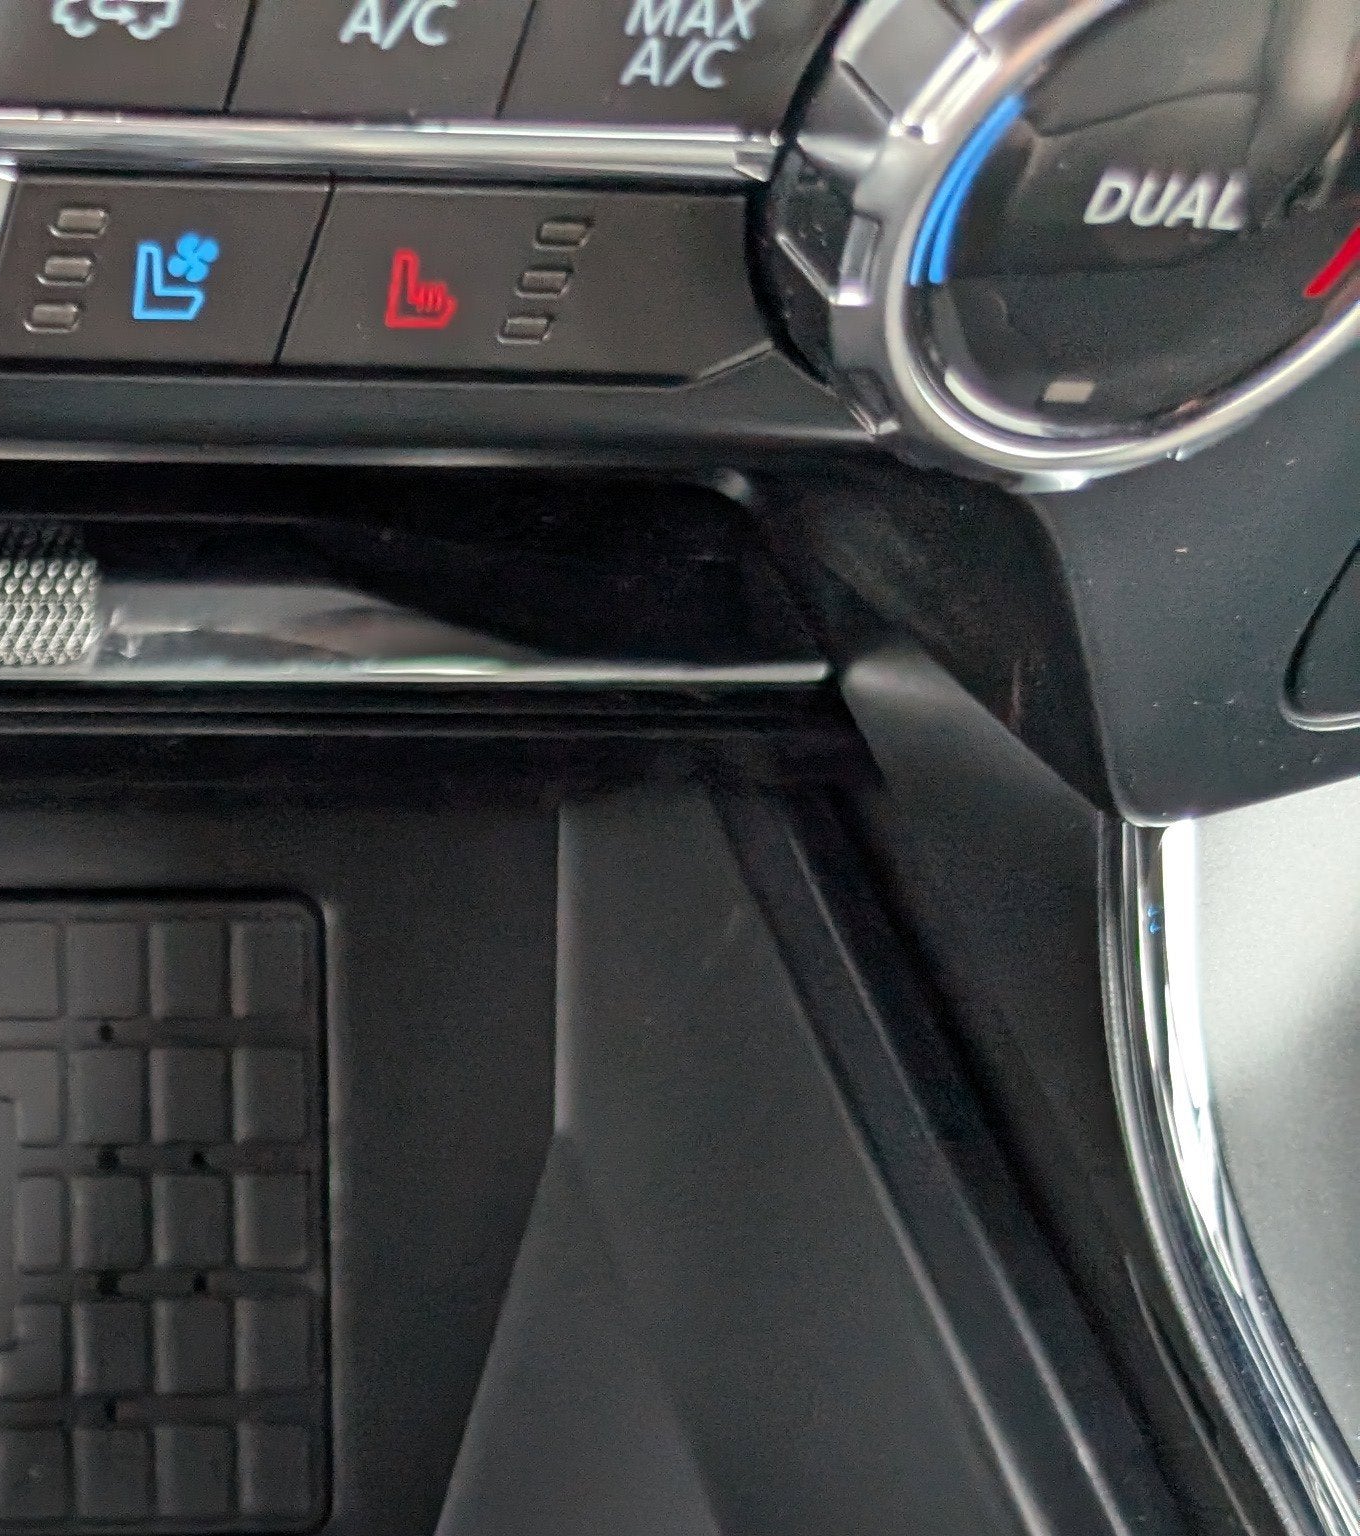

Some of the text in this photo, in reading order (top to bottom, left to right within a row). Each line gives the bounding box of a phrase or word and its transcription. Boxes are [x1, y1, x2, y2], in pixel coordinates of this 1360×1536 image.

[339, 0, 458, 50] A/C
[624, 0, 760, 40] MAX
[619, 37, 739, 89] A/C
[1083, 171, 1248, 230] DUAL
